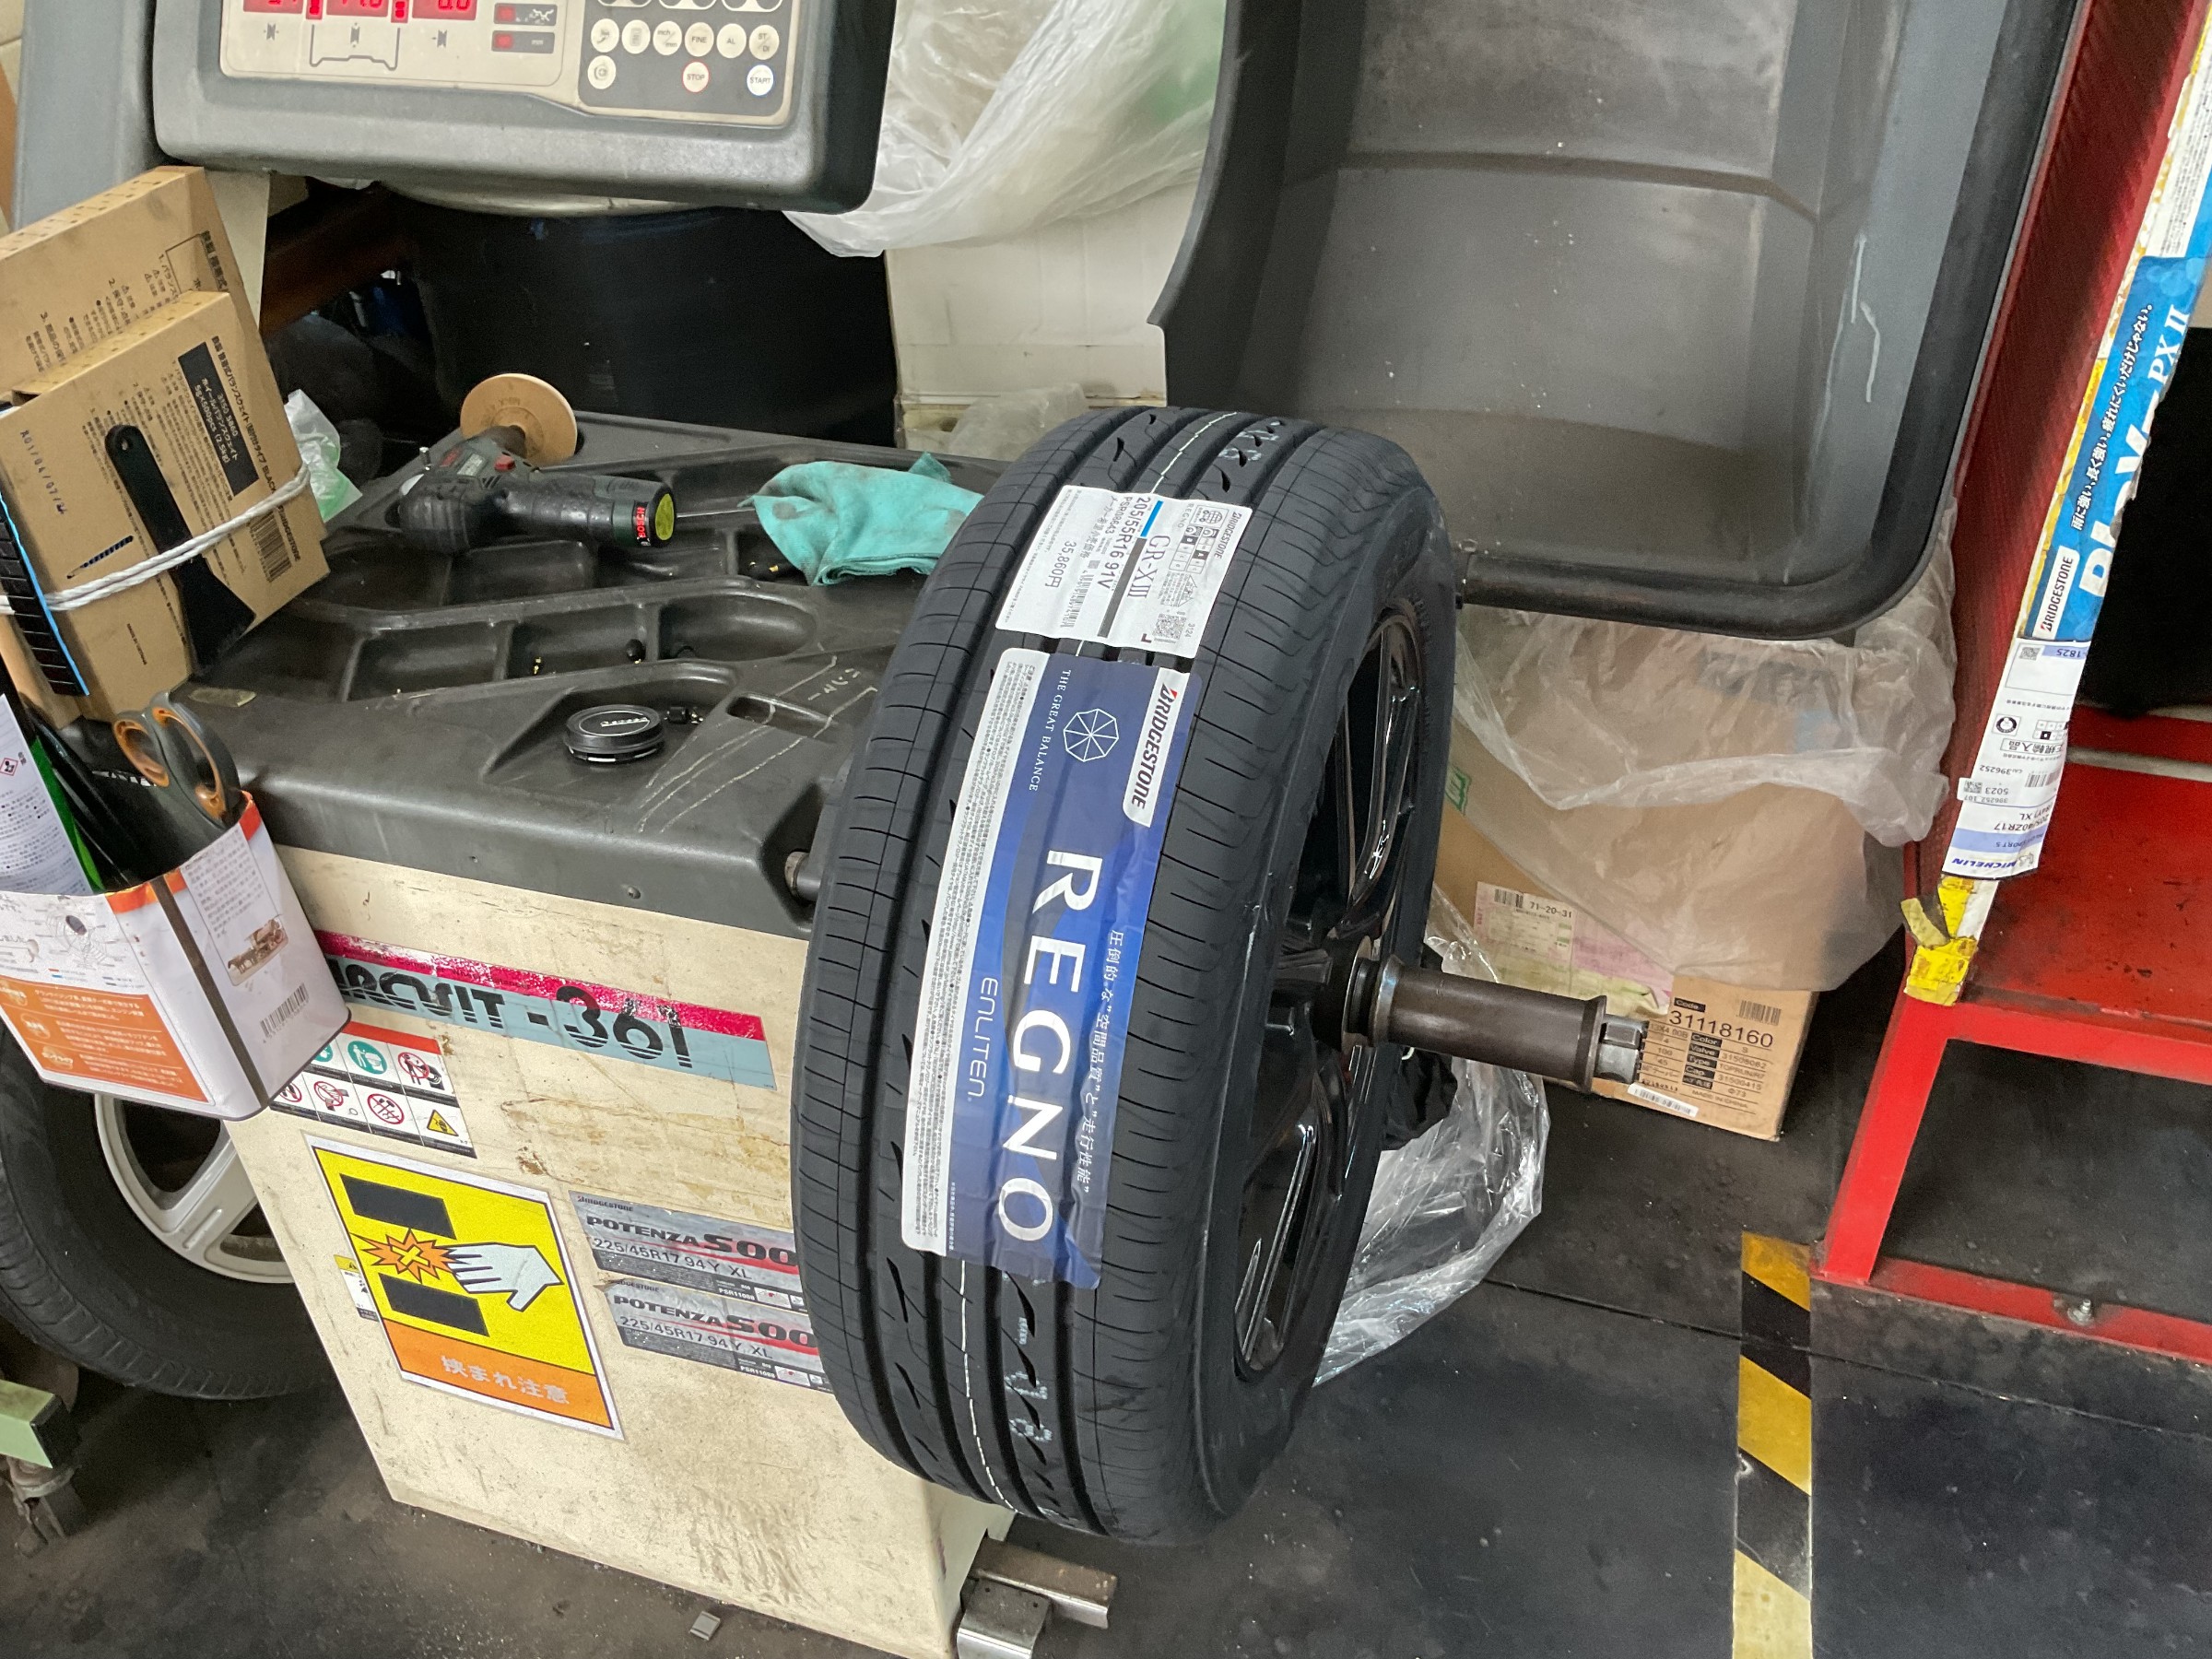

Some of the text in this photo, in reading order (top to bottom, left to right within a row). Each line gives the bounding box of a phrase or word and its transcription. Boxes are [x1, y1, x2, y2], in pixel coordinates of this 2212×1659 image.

[2145, 345, 2179, 385] PX
[217, 392, 239, 437] 3150 5860
[261, 465, 276, 493] BLACK
[635, 507, 647, 538] BOSCH
[1078, 494, 1120, 559] メーカー希望小売価格
[1103, 495, 1133, 535] PSR08643
[1176, 503, 1194, 528] REGNO
[1094, 496, 1151, 589] 205/55R16 91V
[1212, 511, 1242, 559] BRIDGESTONE
[1043, 540, 1079, 587] 35,860円
[2038, 557, 2074, 631] BRIDGESTONE
[1183, 622, 1195, 637] 3124
[1027, 669, 1071, 791] THE GREAT BALANCE
[1128, 683, 1179, 809] BRIDGESTONE
[1980, 765, 2010, 774] 396252
[1952, 858, 2017, 868] MICHELIN
[1530, 901, 1571, 918] 71-20-31
[1677, 1000, 1699, 1009] Code
[966, 977, 999, 1098] ENLITEN
[998, 849, 1103, 1241] REGNO
[1669, 1010, 1773, 1048] 31118160
[1691, 1033, 1717, 1045] Color
[1688, 1055, 1710, 1066] Type
[1691, 1044, 1715, 1057] Valve
[1686, 1066, 1706, 1077] Cap
[1692, 1089, 1712, 1099] MADE
[1724, 1098, 1748, 1108] CHINA
[577, 1195, 633, 1212] BRIDGESTONE
[586, 1216, 701, 1247] POTENZA
[594, 1238, 679, 1264] 225/45R17
[729, 1265, 752, 1280] XL
[614, 1295, 724, 1327] POTENZA
[619, 1316, 702, 1342] 225/45R17
[752, 1346, 773, 1359] XL
[441, 1355, 570, 1404] 挟まれ注意
